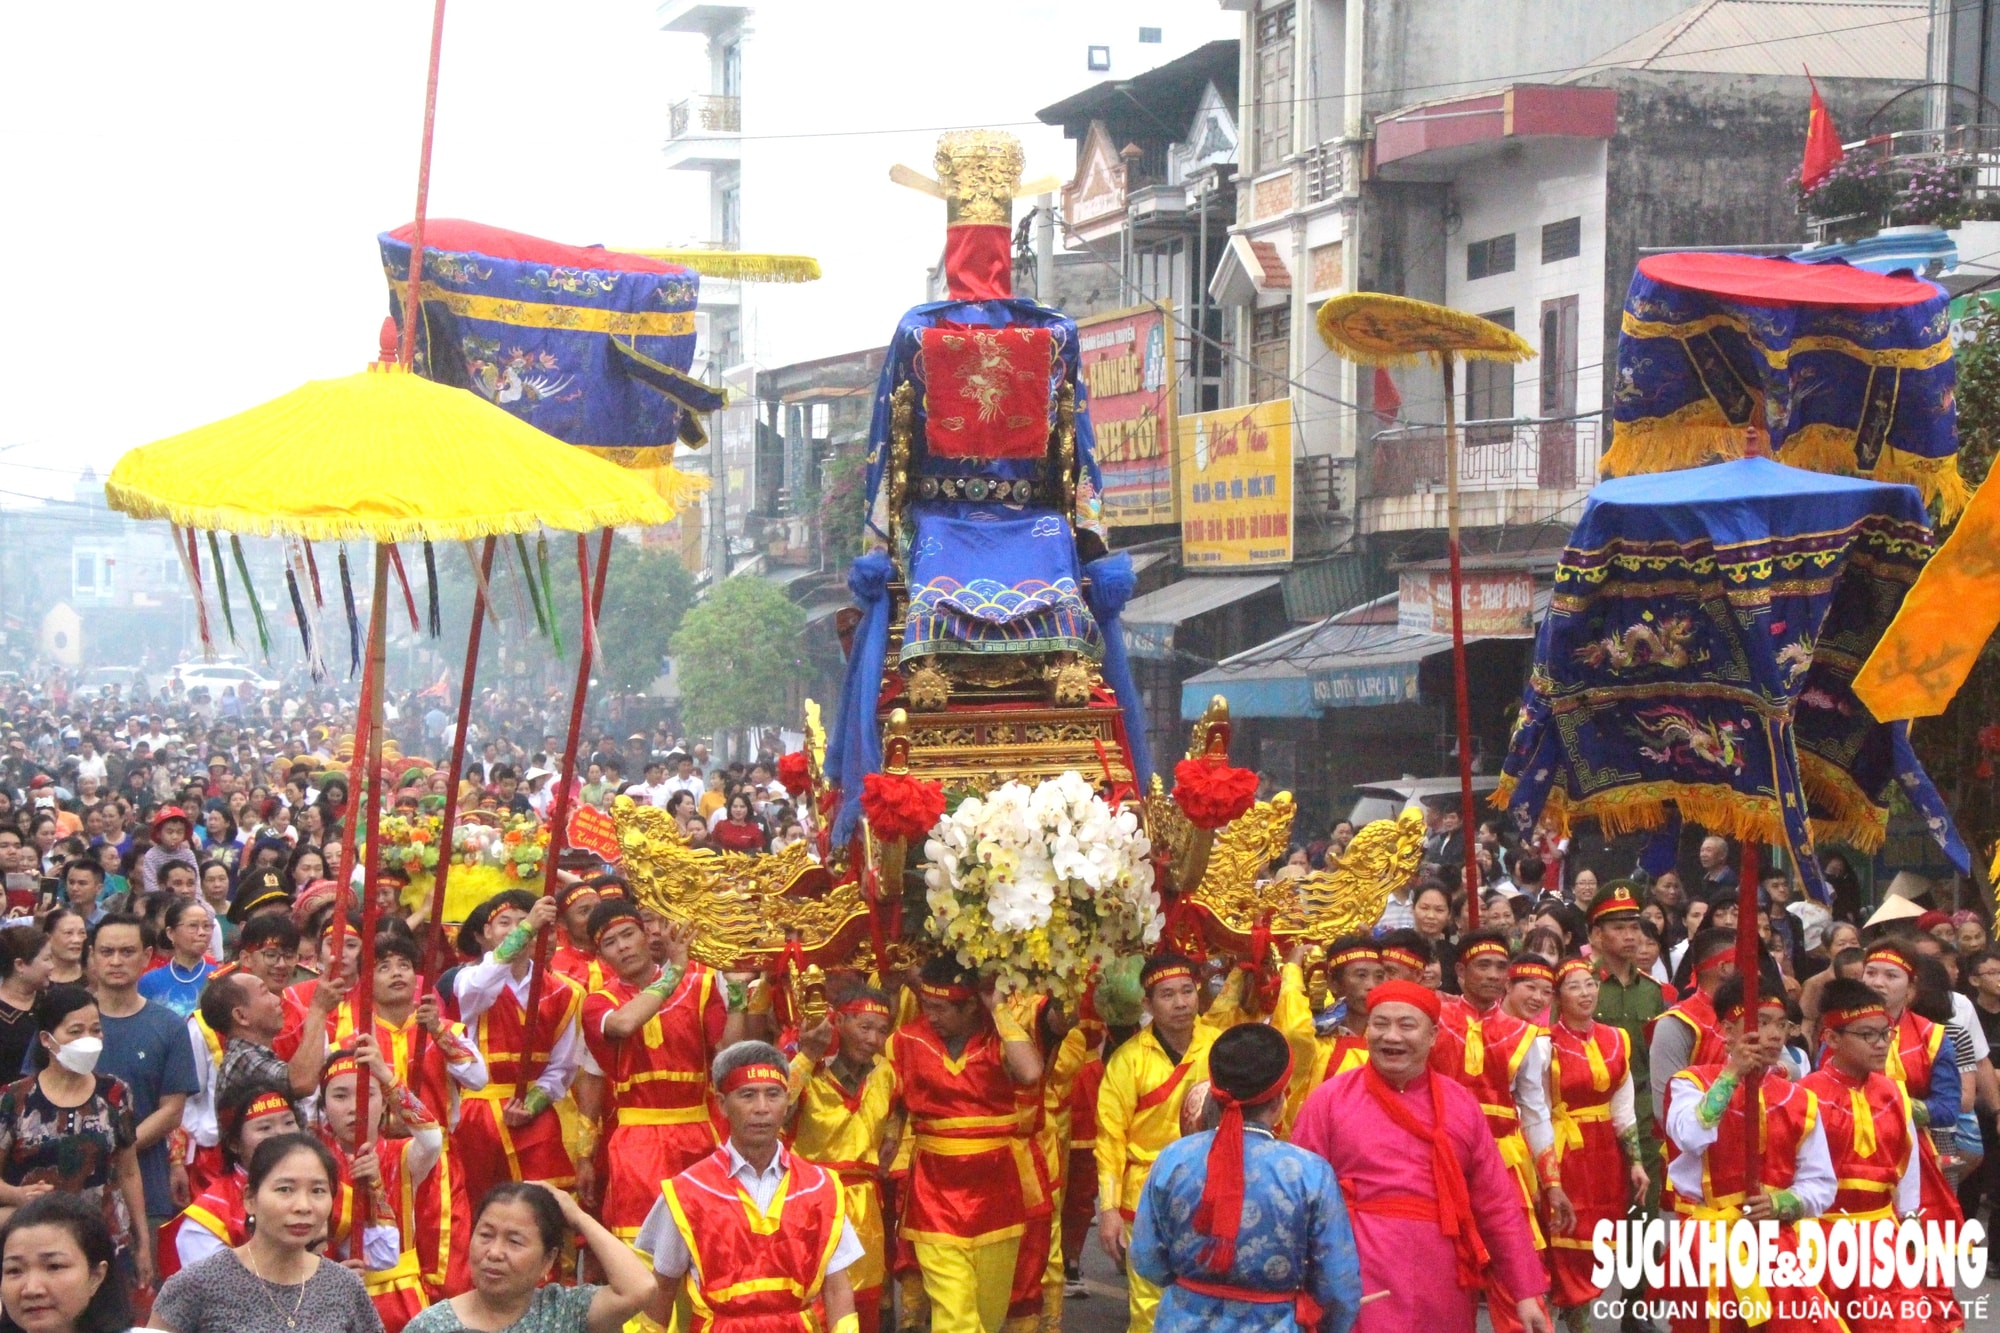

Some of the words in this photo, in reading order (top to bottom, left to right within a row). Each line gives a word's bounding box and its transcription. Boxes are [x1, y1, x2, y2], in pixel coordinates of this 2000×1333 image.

[1090, 353, 1119, 398] BÁNH
[747, 1067, 756, 1079] LỄ
[757, 1068, 770, 1080] HỘI
[252, 1100, 266, 1113] HỘI
